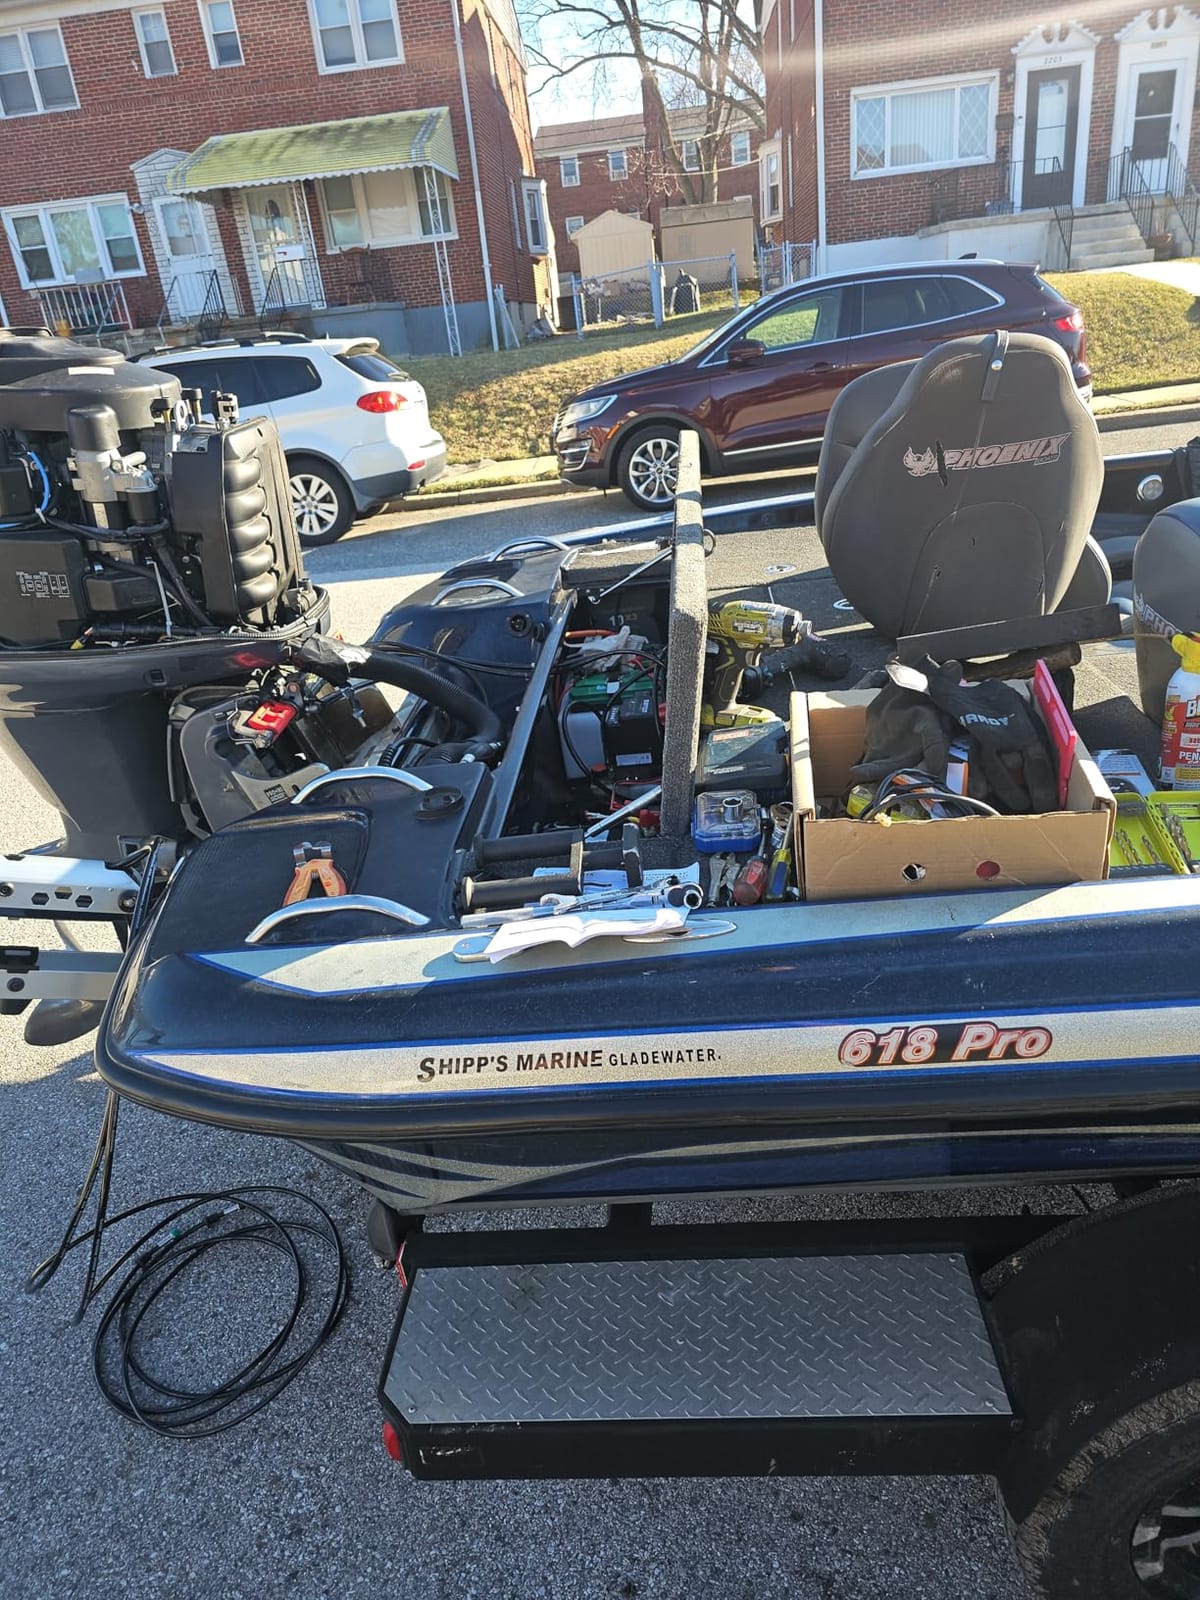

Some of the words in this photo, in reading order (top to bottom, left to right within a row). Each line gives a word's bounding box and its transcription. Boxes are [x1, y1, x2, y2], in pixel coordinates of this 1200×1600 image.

[943, 432, 1071, 470] PHOENIX
[838, 1026, 939, 1067] 618
[951, 1021, 1053, 1062] Pro
[417, 1055, 508, 1083] SHIPP'S
[516, 1050, 603, 1071] MARINE
